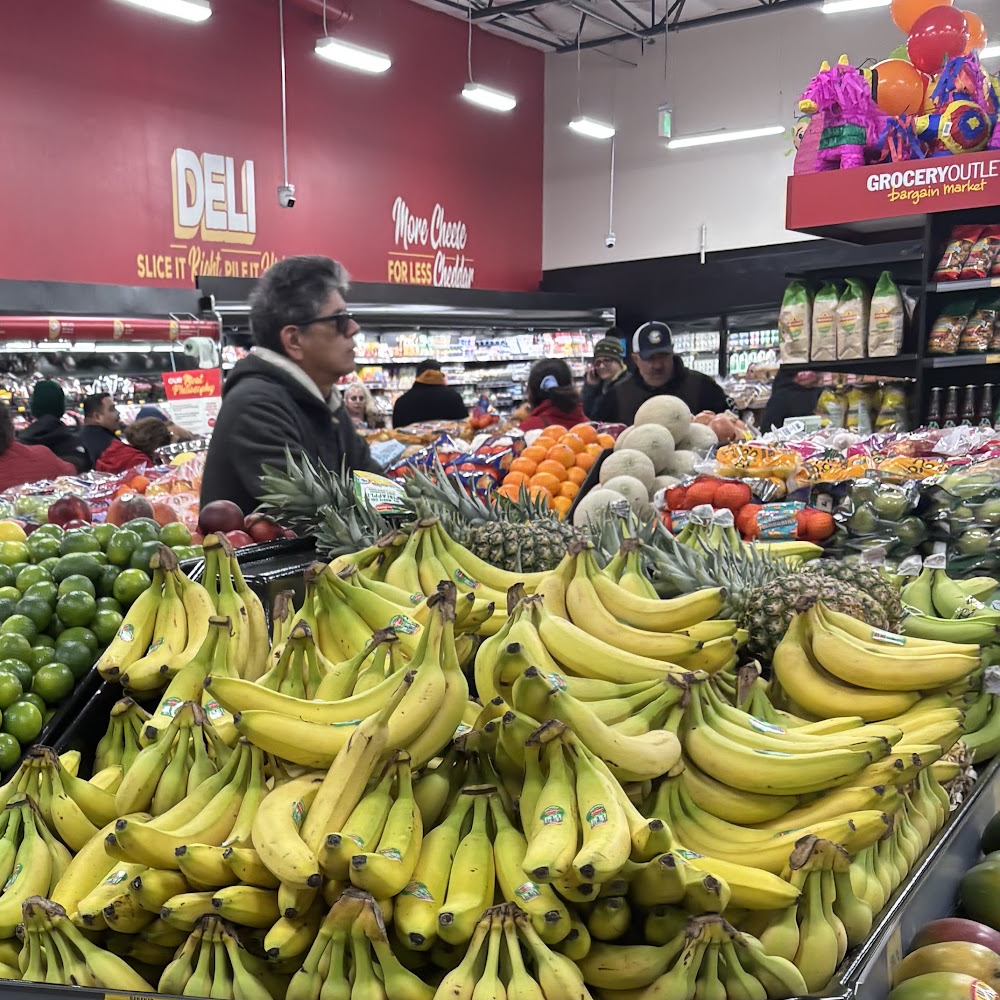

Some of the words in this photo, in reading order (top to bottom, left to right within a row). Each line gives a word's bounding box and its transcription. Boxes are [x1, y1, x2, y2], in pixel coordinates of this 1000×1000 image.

[867, 159, 1000, 192] GROCERYOUTLE
[888, 185, 939, 205] bargain
[943, 178, 987, 195] market
[171, 148, 256, 245] DELI
[392, 196, 429, 250] More
[430, 203, 467, 250] Cheese
[137, 254, 172, 279] SLICE
[175, 257, 186, 279] IT
[388, 260, 408, 283] FOR
[410, 262, 432, 285] LESS
[433, 250, 474, 289] Cheddar
